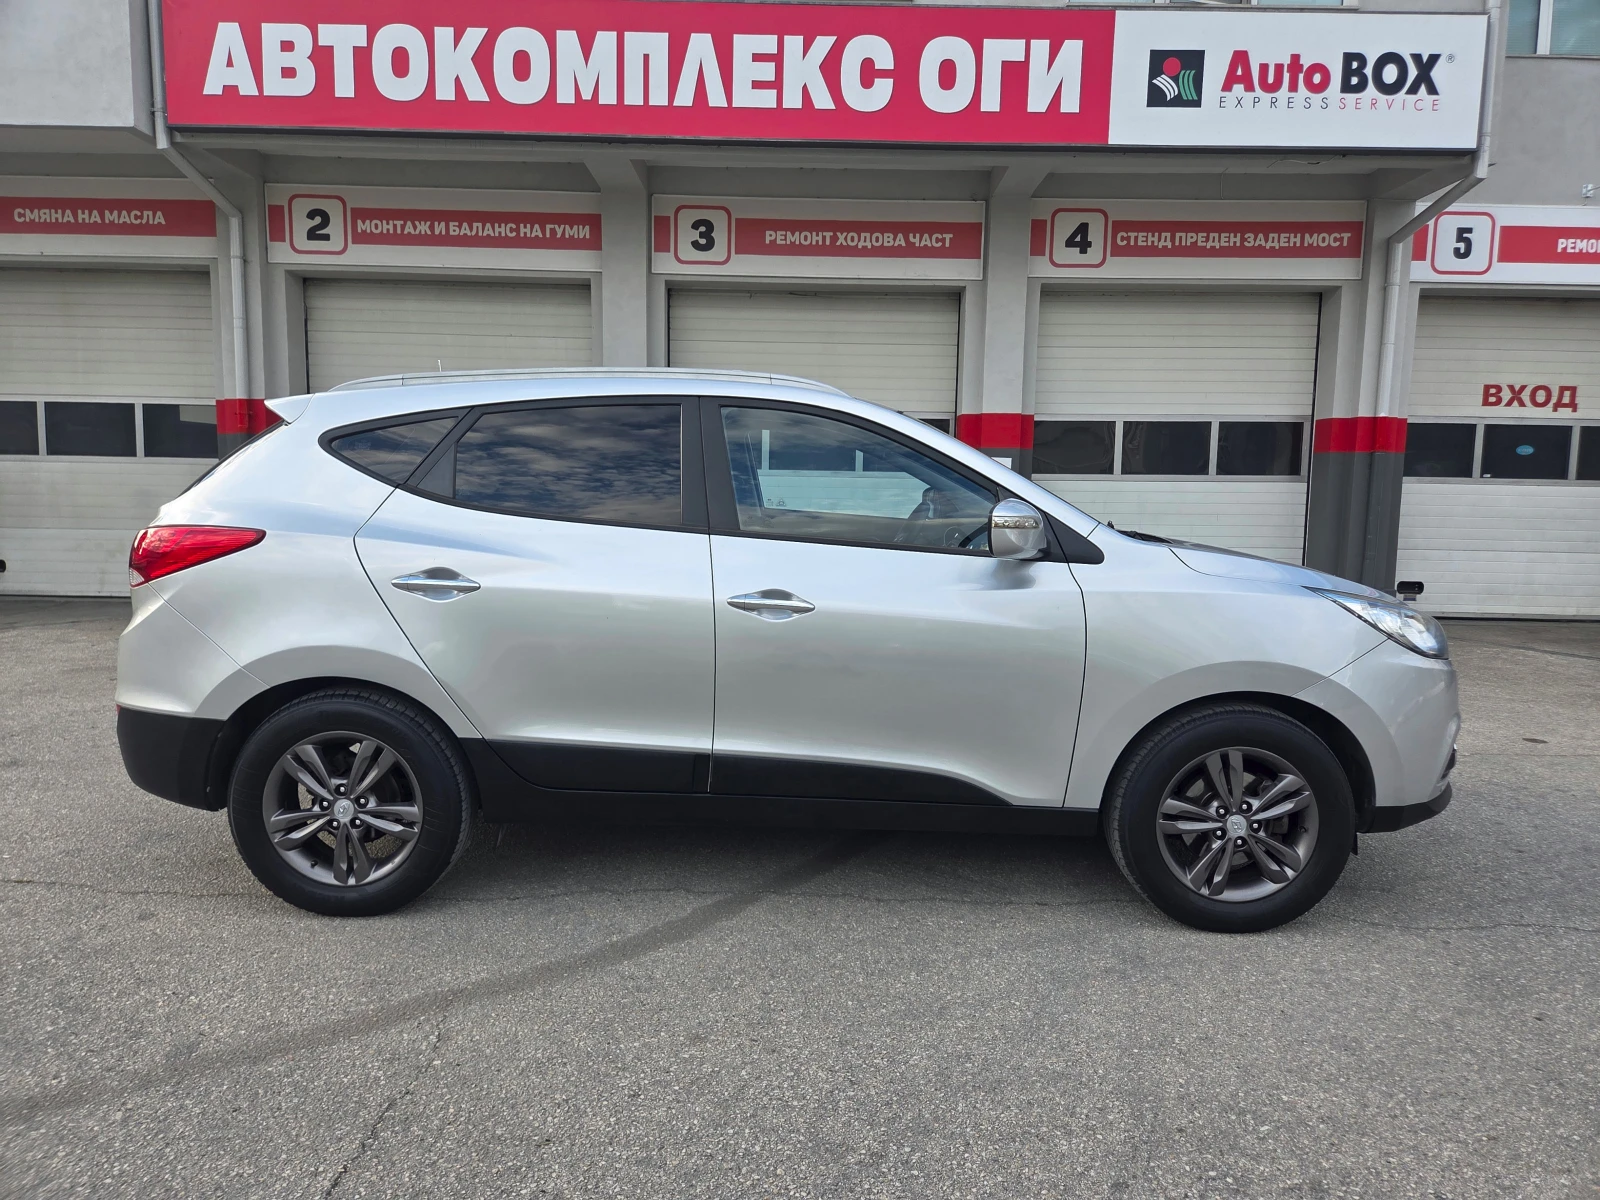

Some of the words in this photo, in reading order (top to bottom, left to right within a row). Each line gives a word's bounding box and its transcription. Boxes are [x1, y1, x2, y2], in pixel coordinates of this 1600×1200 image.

[203, 22, 895, 112] АВТОКОМПЛЕКС
[918, 36, 1084, 114] ОГИ
[1220, 49, 1331, 95] Auto
[1339, 51, 1441, 96] BOX
[13, 208, 75, 223] СМЯНА
[77, 210, 101, 224] НА
[104, 210, 166, 225] МАСЛА
[305, 208, 331, 242] 2
[356, 219, 431, 235] МОНТАЖ
[434, 221, 446, 235] И
[449, 222, 517, 238] БАЛАНС
[519, 224, 543, 238] НА
[546, 224, 591, 239] ГУМИ
[690, 218, 716, 252] 3
[765, 231, 833, 246] РЕМОНТ
[836, 232, 906, 249] ХОДОВА
[909, 233, 954, 248] ЧАСТ
[1064, 222, 1093, 255] 4
[1116, 231, 1172, 249] СТЕНД
[1175, 232, 1241, 249] ПРЕДЕН
[1244, 233, 1301, 249] ЗАДЕН
[1304, 233, 1352, 248] МОСТ
[1452, 227, 1474, 260] 5
[1557, 238, 1600, 254] РЕМО
[1481, 384, 1579, 413] ВХОД
